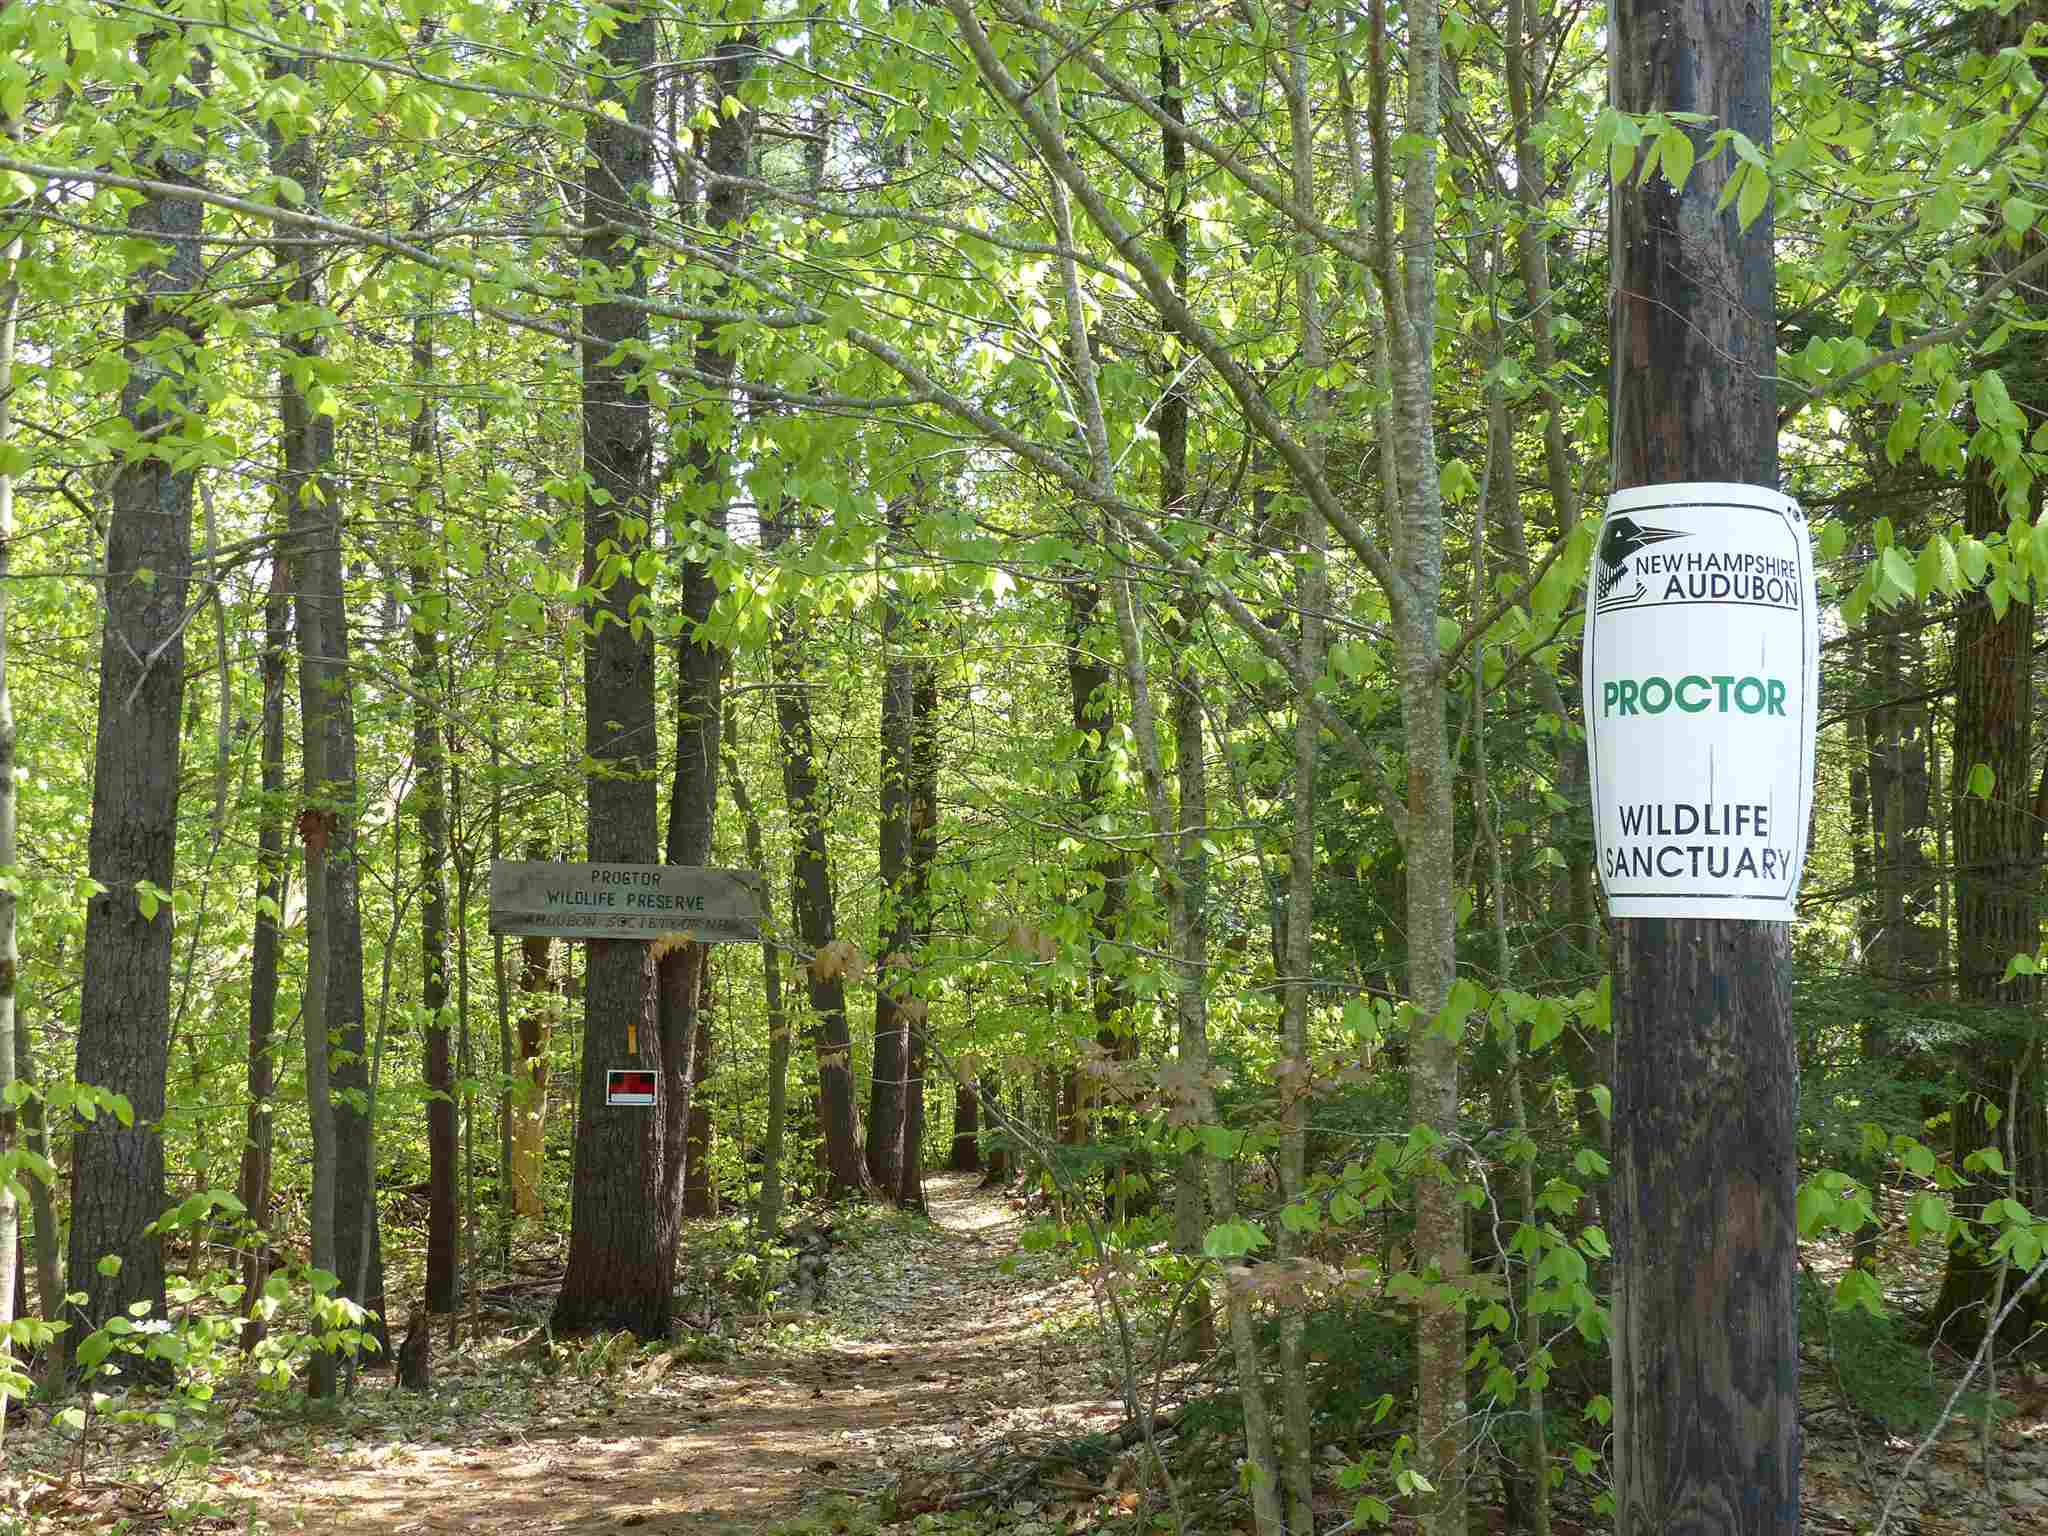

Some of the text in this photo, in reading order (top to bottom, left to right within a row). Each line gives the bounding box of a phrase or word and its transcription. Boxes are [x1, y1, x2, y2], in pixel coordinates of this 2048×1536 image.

[1635, 552, 1796, 579] NEW HAMPSHIRE
[1662, 575, 1798, 606] AUDUBON
[1603, 675, 1787, 718] PROCTOR
[1618, 804, 1768, 837] WILDLIFE
[1607, 845, 1791, 880] SANCTUARY
[592, 870, 662, 887] PROCTOR
[546, 889, 704, 911] WILDLIFE PRESERVE
